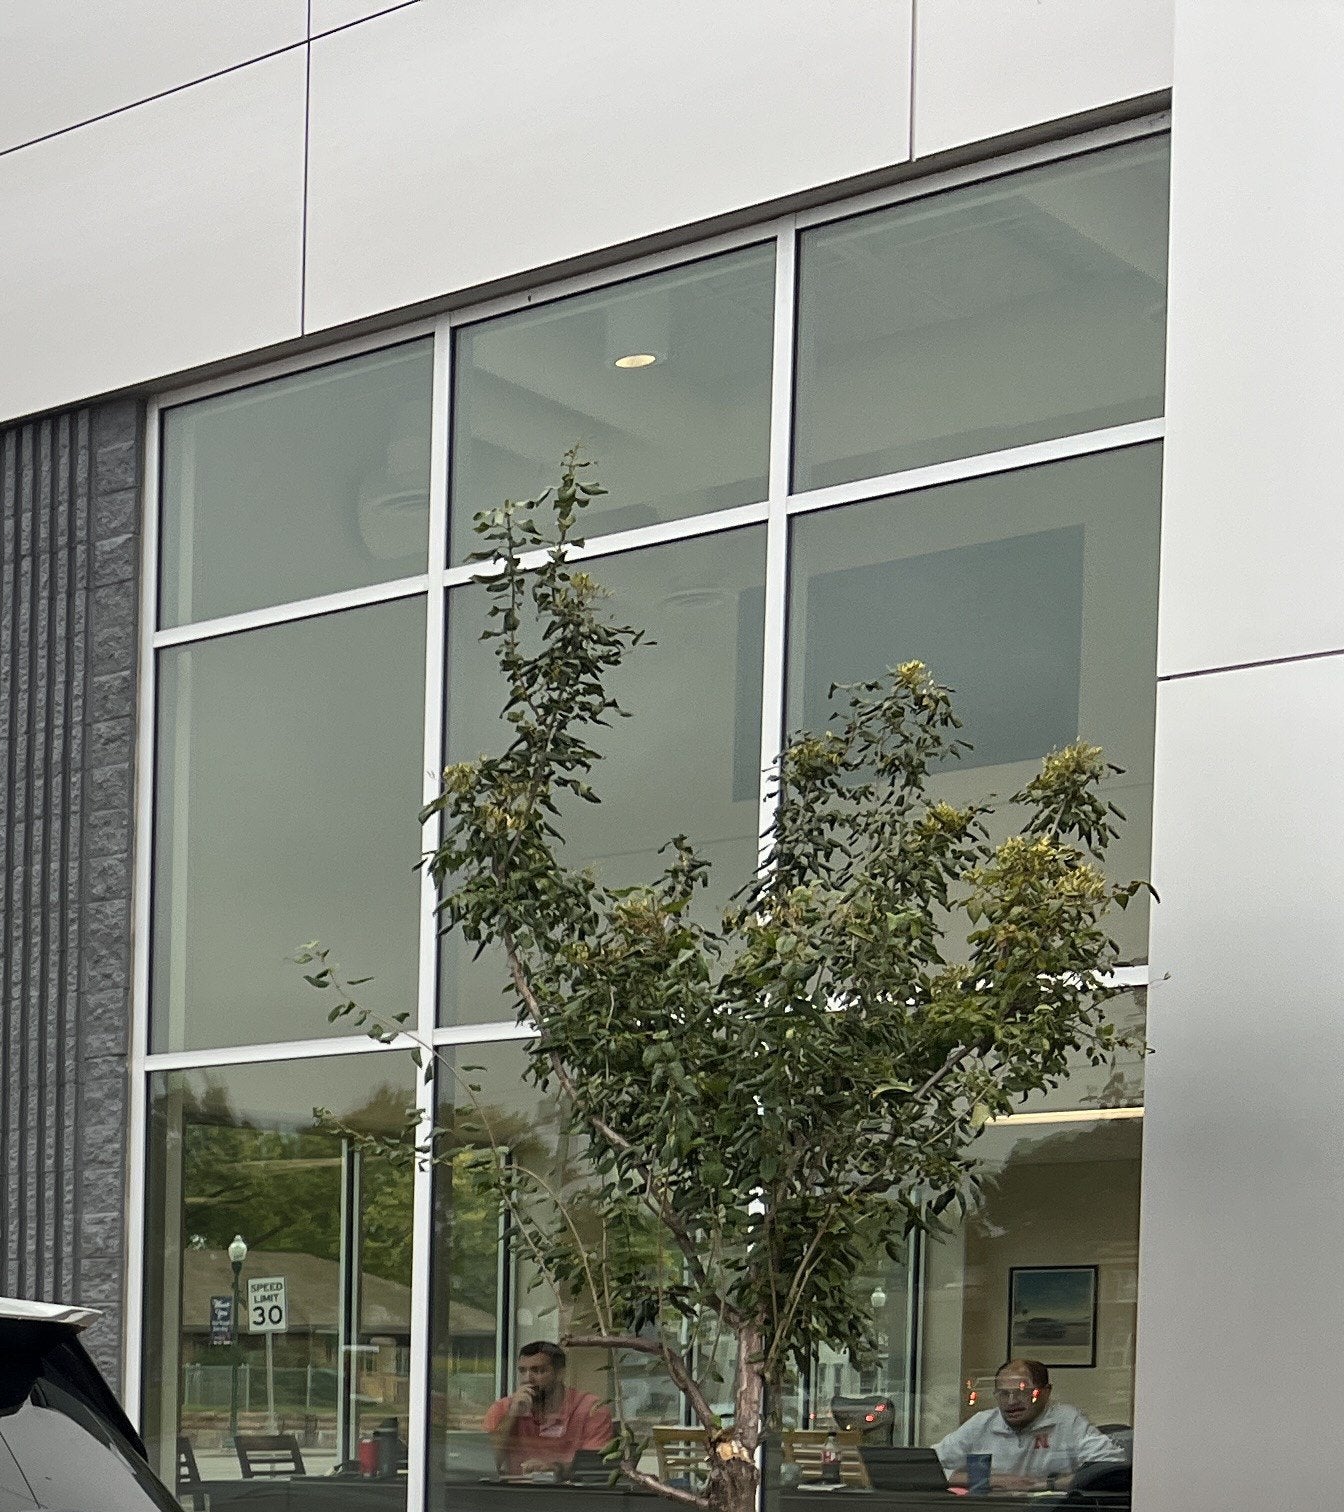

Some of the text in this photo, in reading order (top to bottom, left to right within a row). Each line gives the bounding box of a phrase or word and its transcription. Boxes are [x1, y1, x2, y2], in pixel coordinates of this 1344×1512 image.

[251, 1282, 283, 1293] SPEED
[254, 1294, 279, 1303] LIMIT
[252, 1305, 283, 1326] 30
